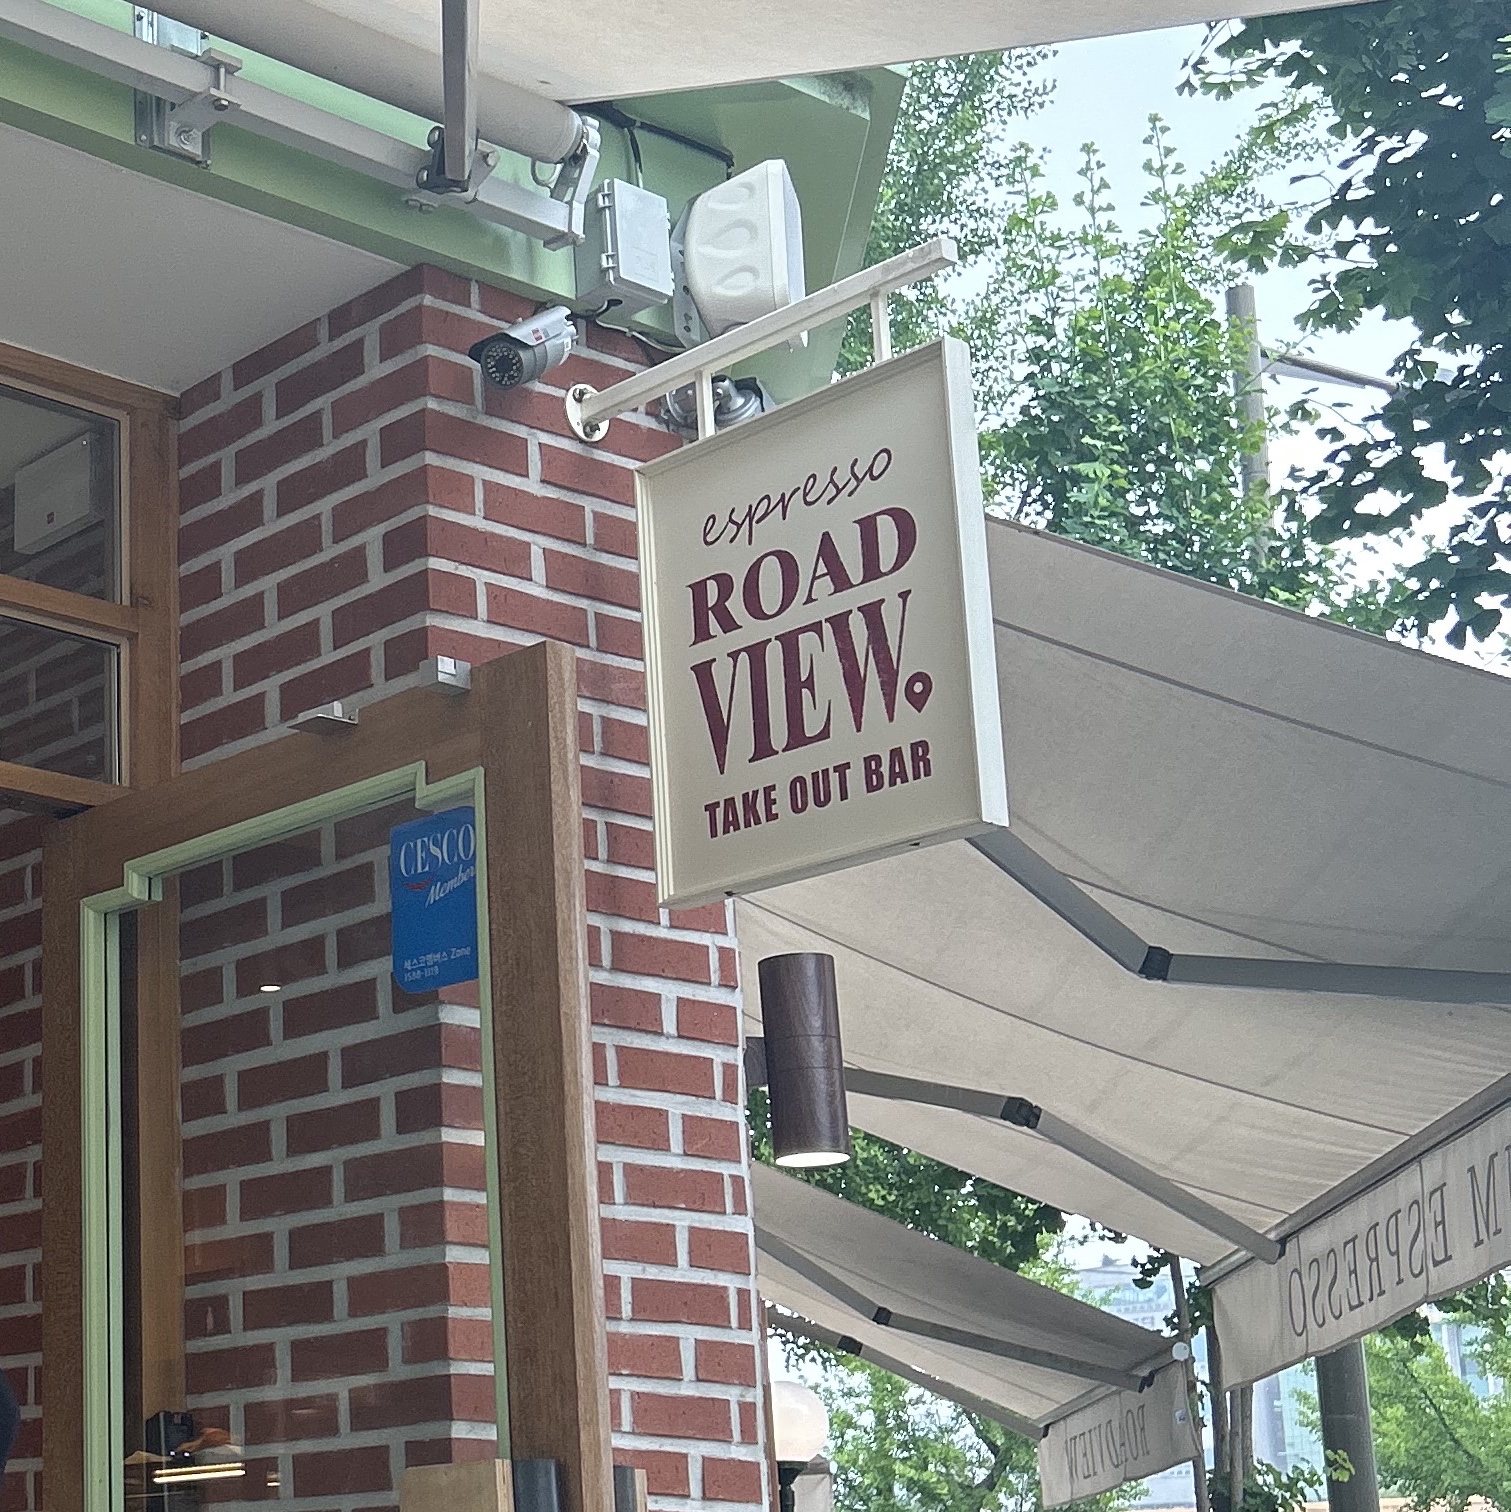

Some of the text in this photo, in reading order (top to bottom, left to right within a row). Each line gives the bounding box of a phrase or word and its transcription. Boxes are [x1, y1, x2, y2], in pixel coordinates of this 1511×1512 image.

[702, 447, 892, 546] espresso
[686, 506, 917, 648] ROAD
[690, 589, 913, 775] VIEW
[705, 739, 933, 839] TAKE OUT BAR
[399, 823, 476, 878] CESCO
